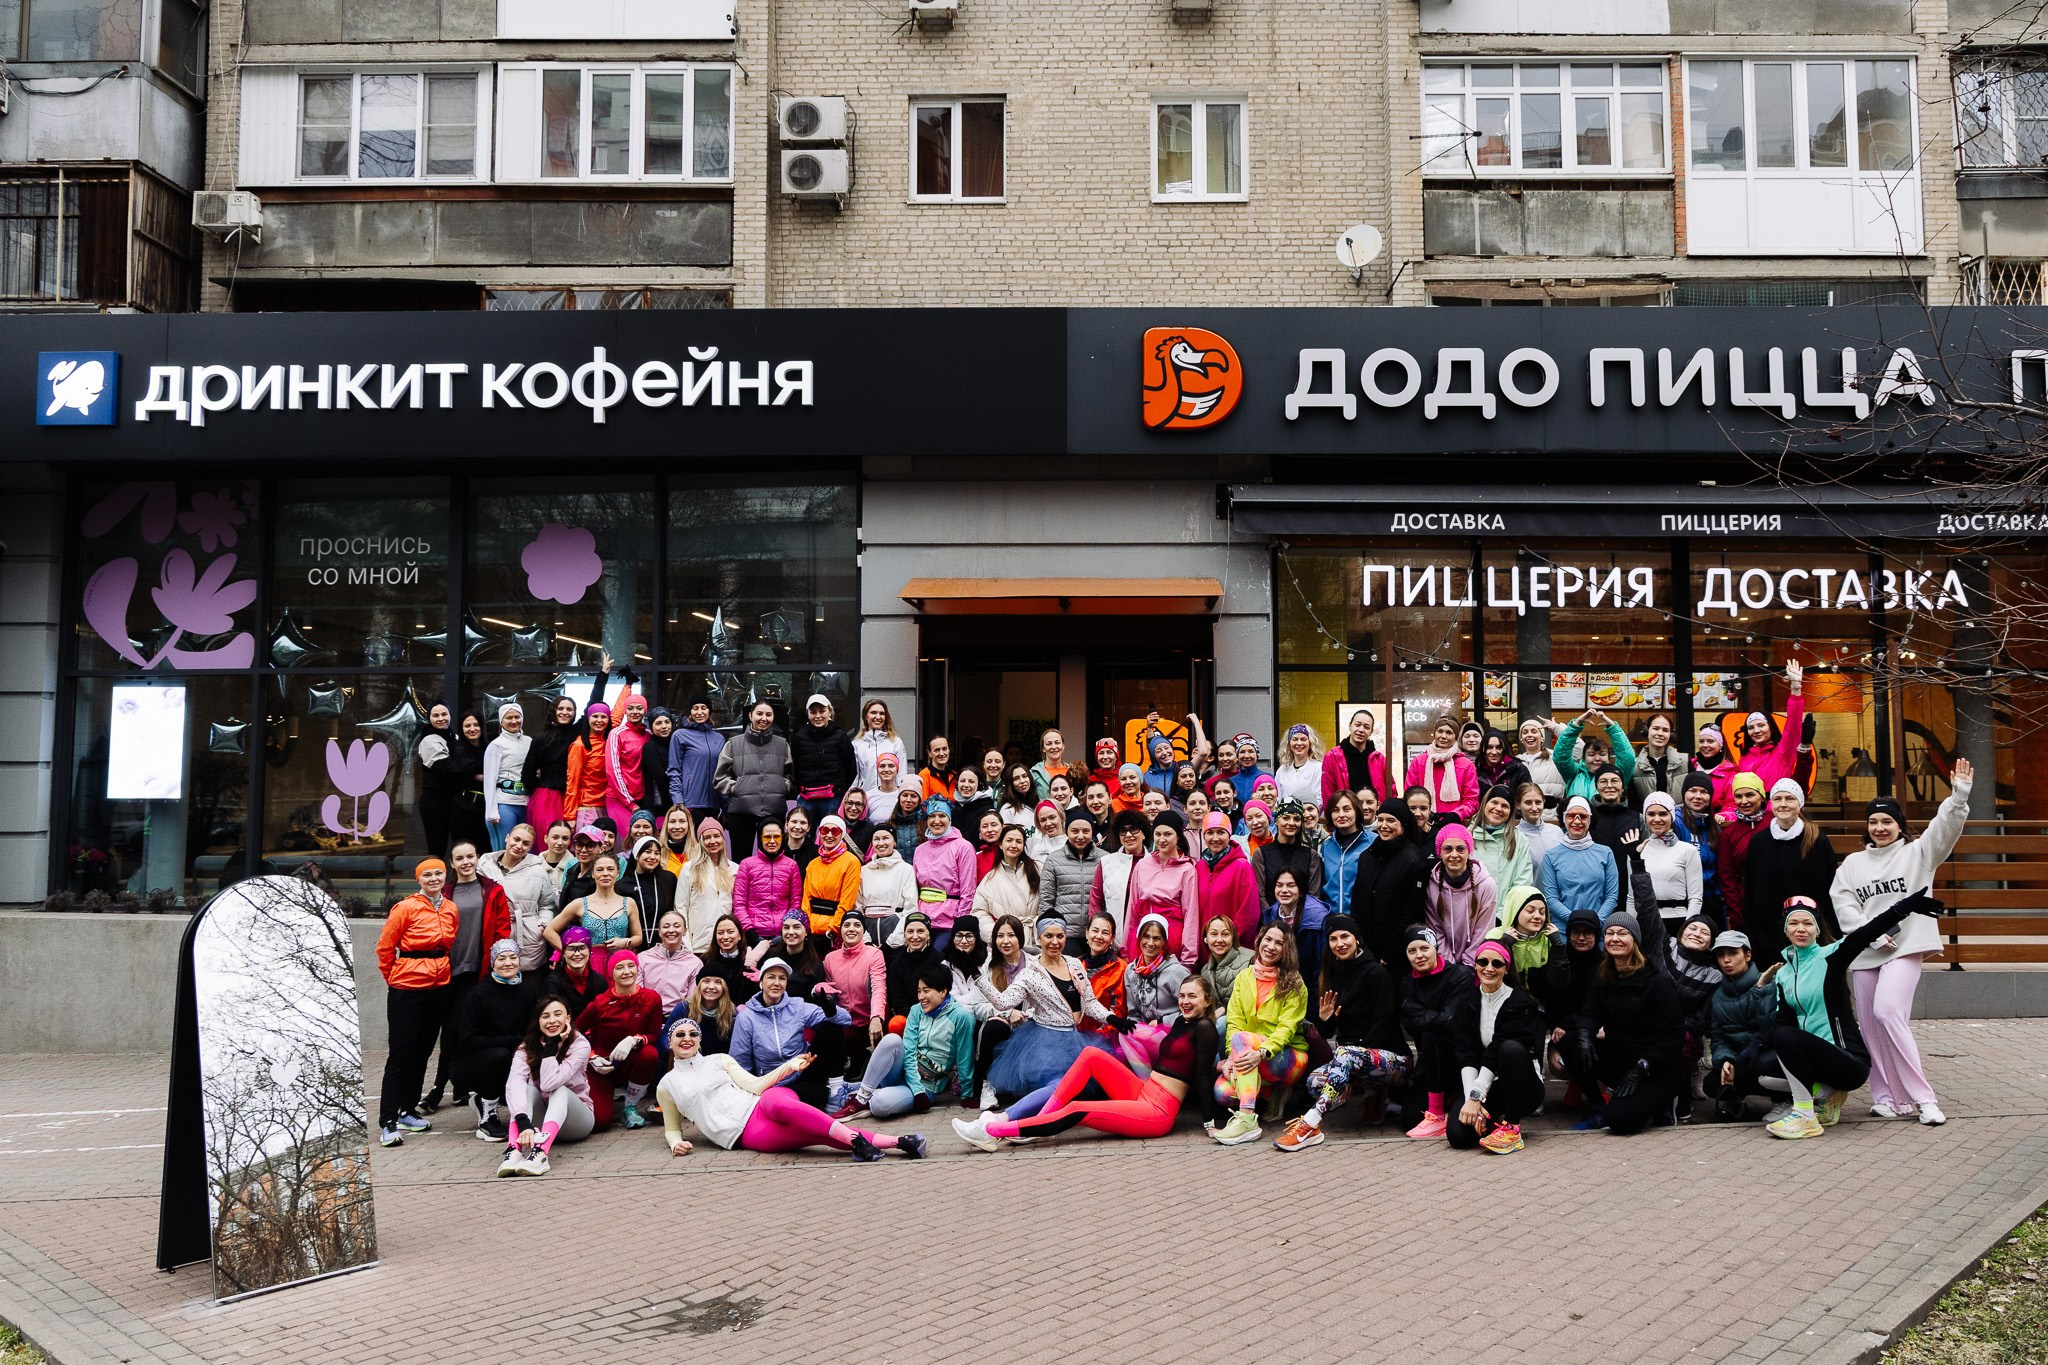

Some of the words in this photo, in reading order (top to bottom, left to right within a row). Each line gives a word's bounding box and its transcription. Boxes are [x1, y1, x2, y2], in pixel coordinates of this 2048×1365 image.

[135, 363, 469, 428] дринкит
[482, 346, 814, 424] кофейня
[1285, 347, 1560, 420] ДОДО
[1589, 346, 1936, 420] ПИЦЦА
[1390, 513, 1506, 533] ДОСТАВКА
[1660, 514, 1782, 534] ПИЦЦЕРИЯ
[1937, 514, 2048, 534] ДОСТАВКА
[300, 537, 431, 561] проснись
[308, 568, 339, 586] со
[348, 561, 419, 585] мной
[1363, 565, 1654, 617] ПИЦЦЕРИЯ
[1697, 567, 1969, 617] ДОСТАВКА
[1855, 877, 1907, 903] BALANCE
